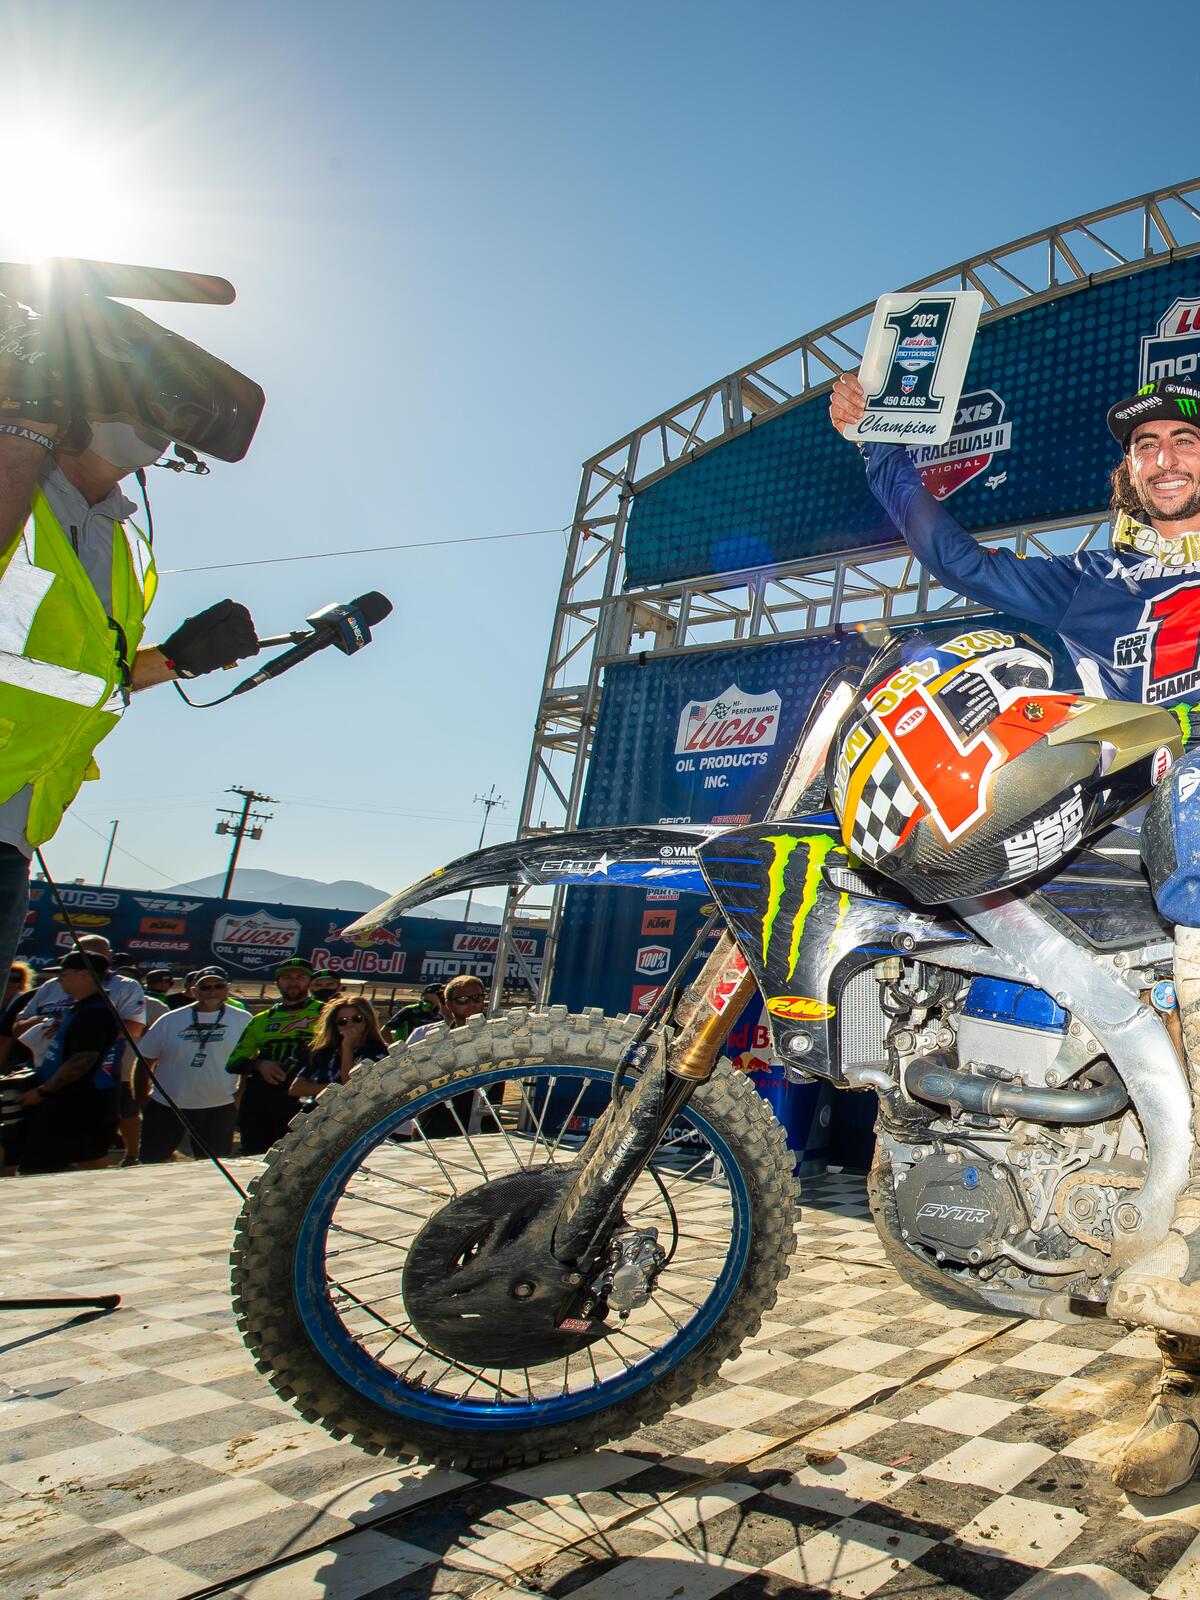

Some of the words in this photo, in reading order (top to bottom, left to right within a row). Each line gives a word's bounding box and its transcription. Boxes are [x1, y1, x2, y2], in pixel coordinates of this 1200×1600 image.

[911, 314, 939, 327] 2021
[865, 297, 956, 413] 1
[883, 397, 899, 406] 450
[900, 396, 926, 406] CLASS
[1124, 396, 1163, 416] YAMAHA
[857, 414, 937, 437] Champion
[921, 431, 993, 462] RACEWAY
[921, 459, 981, 477] ATIONAL
[937, 630, 1015, 659] 2021
[1117, 635, 1147, 650] 2021
[1117, 649, 1148, 667] MX
[870, 657, 942, 716] 450
[731, 704, 779, 716] PERFORMANCE
[899, 710, 923, 731] BELL
[684, 715, 775, 751] LUCAS
[676, 759, 695, 772] OIL
[699, 752, 768, 770] PRODUCTS
[703, 774, 729, 789] INC.
[1033, 809, 1064, 871] WIDE
[1003, 829, 1038, 879] LIVE
[52, 890, 120, 910] WPS
[647, 917, 671, 929] KTM
[128, 941, 191, 951] GASGAS
[223, 929, 295, 945] LUCAS
[457, 936, 499, 950] LUCA
[216, 946, 234, 954] OIL
[237, 947, 292, 957] PRODUCTS
[242, 956, 264, 964] INC.
[311, 948, 361, 973] Red
[362, 951, 407, 974] Bull
[641, 952, 666, 969] 100%
[768, 1000, 836, 1019] FMF
[916, 1203, 991, 1224] GYTR
